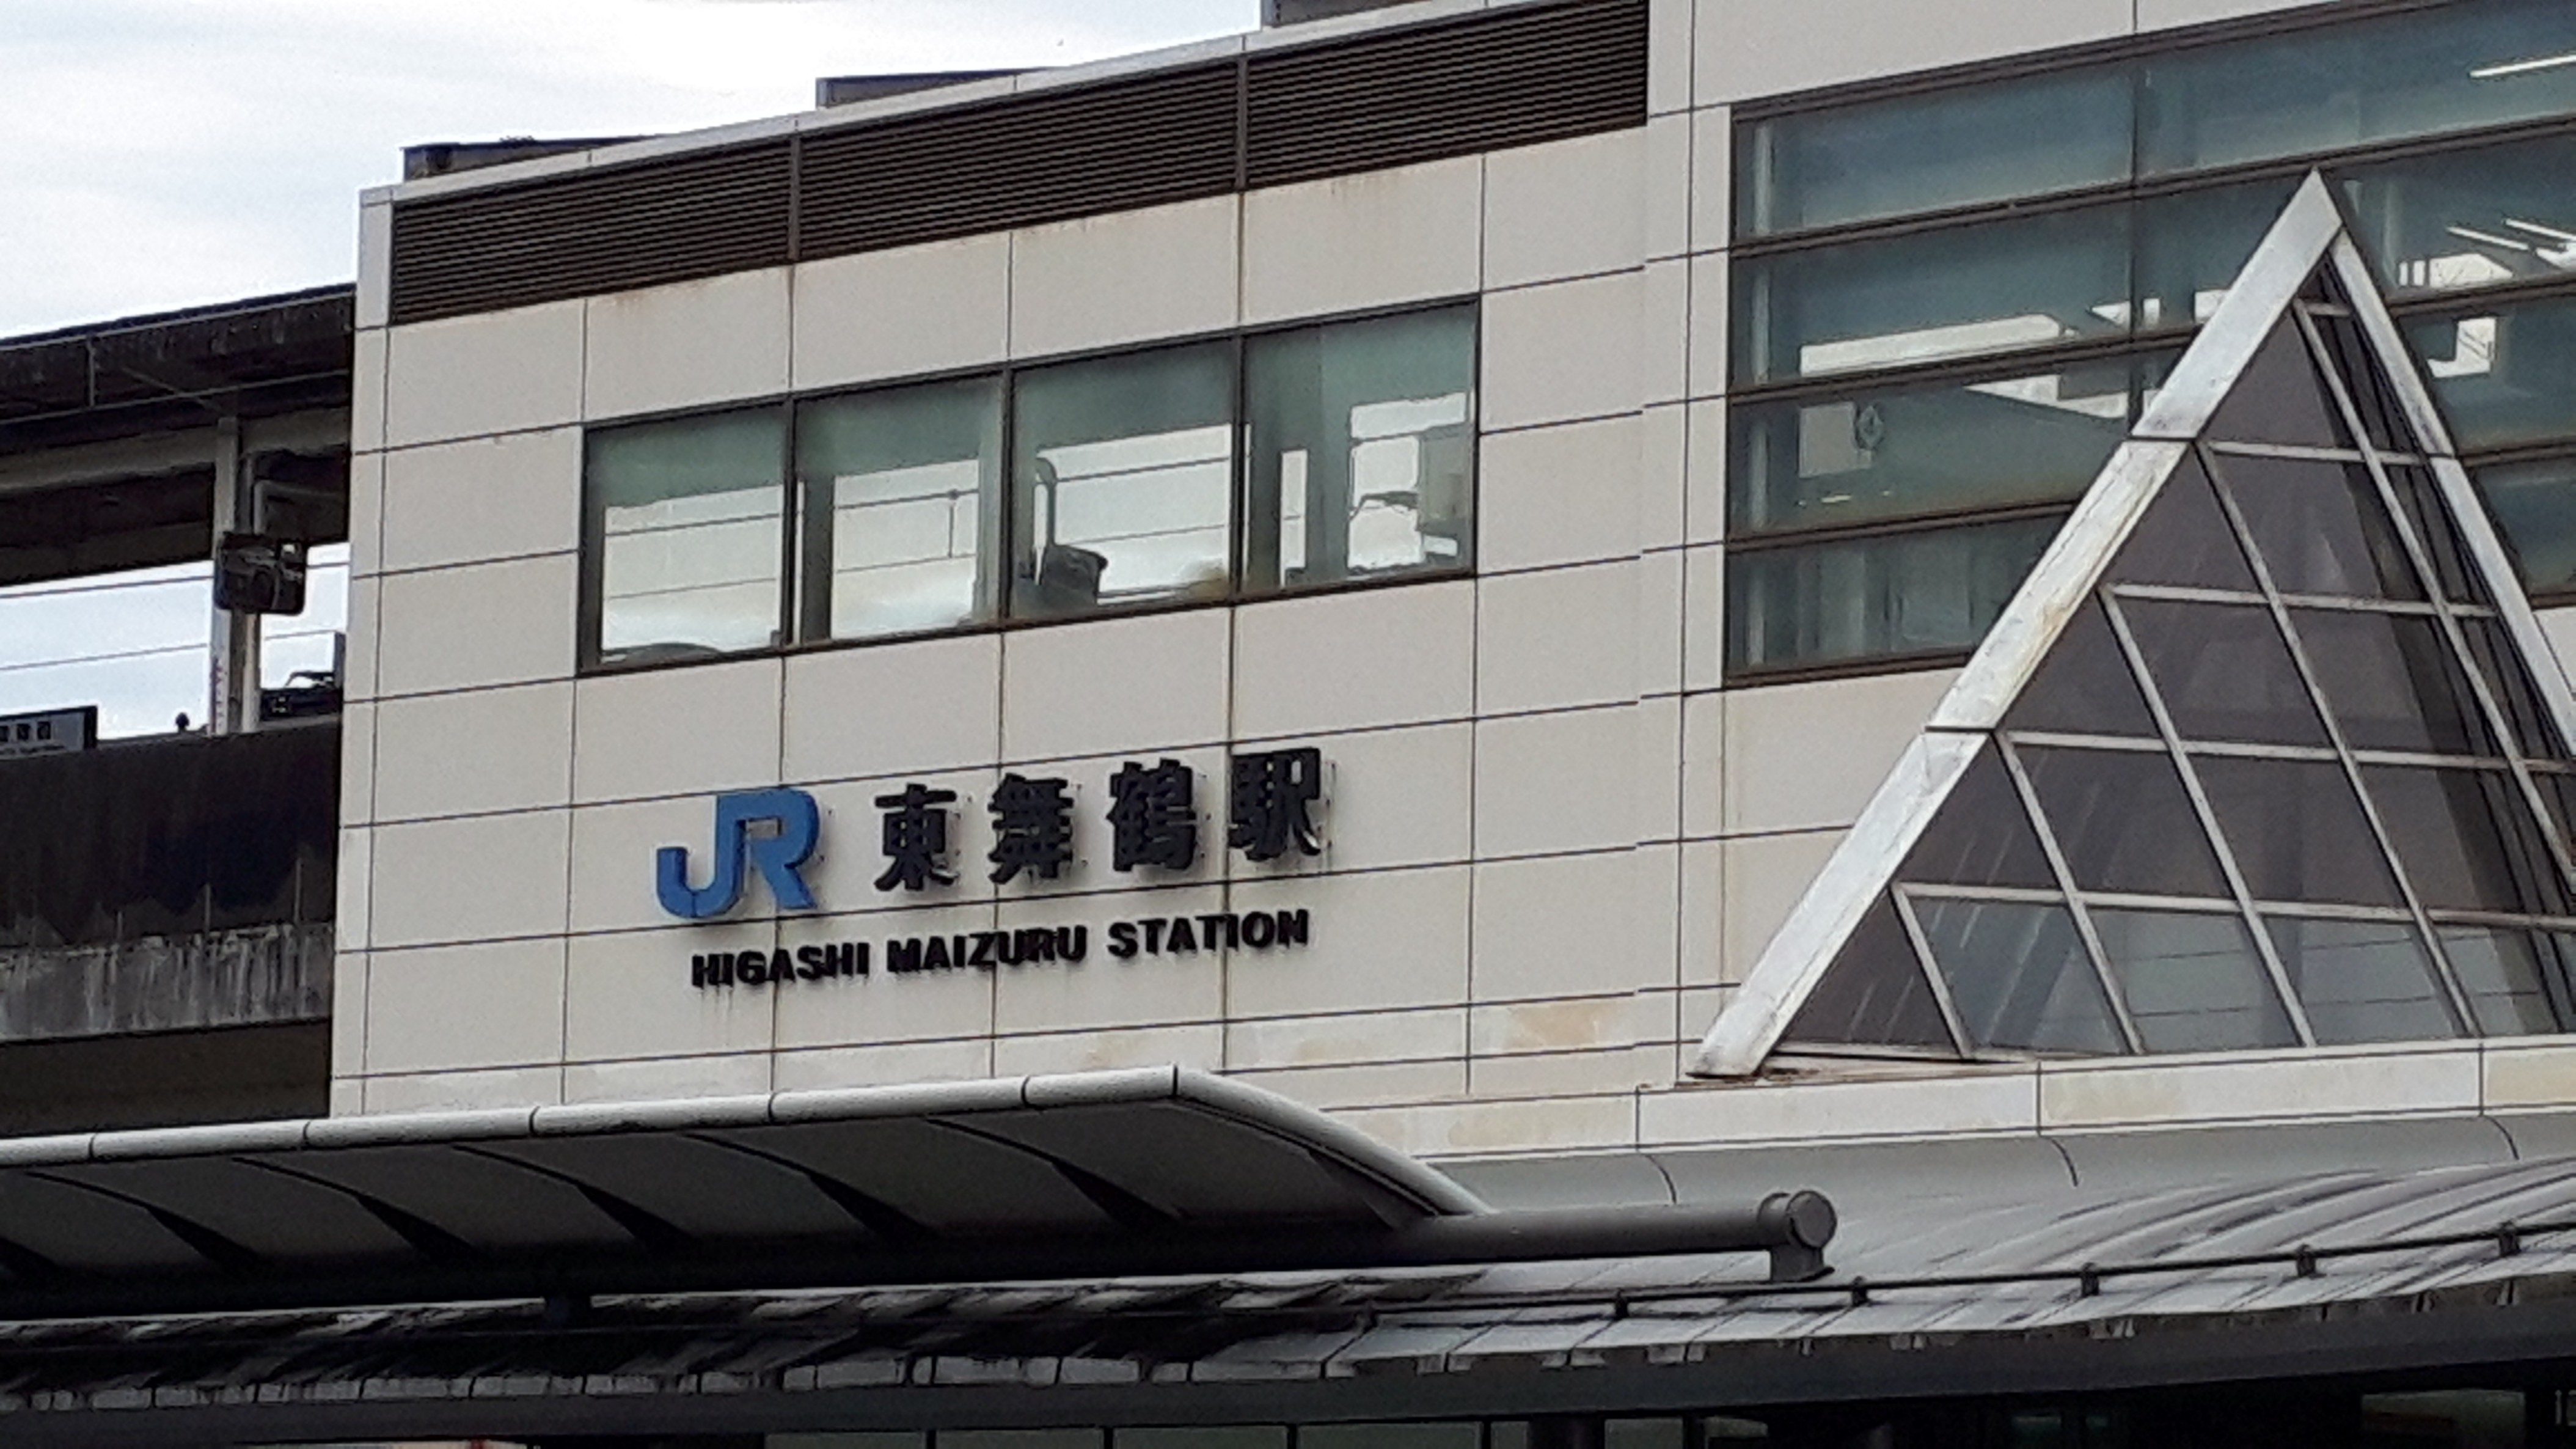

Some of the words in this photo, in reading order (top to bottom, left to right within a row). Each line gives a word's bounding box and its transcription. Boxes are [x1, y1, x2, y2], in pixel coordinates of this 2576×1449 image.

[656, 786, 819, 918] JR
[874, 748, 1321, 891] 東舞鶴駅
[692, 943, 870, 988] HIGASHI
[887, 925, 1088, 973] MAIZURU
[1107, 909, 1309, 958] STATION
